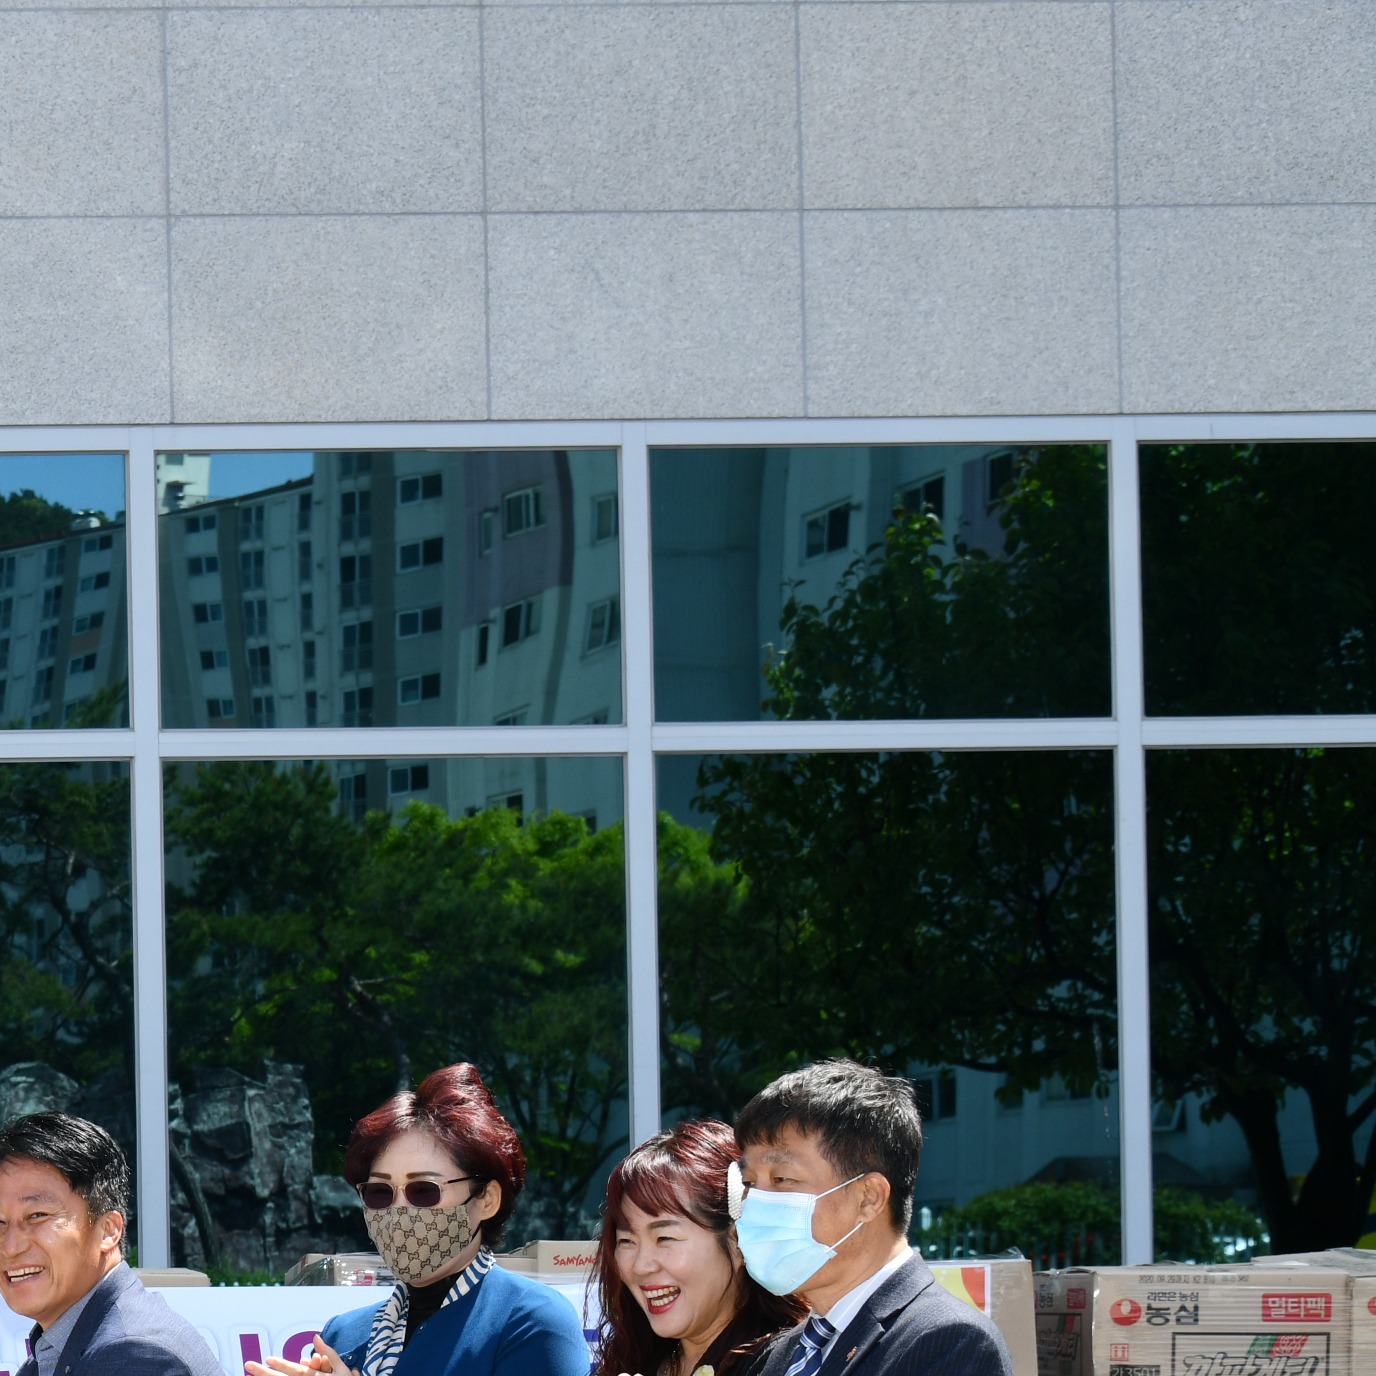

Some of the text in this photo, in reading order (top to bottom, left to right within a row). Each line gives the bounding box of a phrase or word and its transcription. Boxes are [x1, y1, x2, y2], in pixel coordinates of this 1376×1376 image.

[1147, 1291, 1199, 1302] 라면은 농심
[1145, 1303, 1199, 1326] 농심
[1267, 1297, 1326, 1319] 멀티팩
